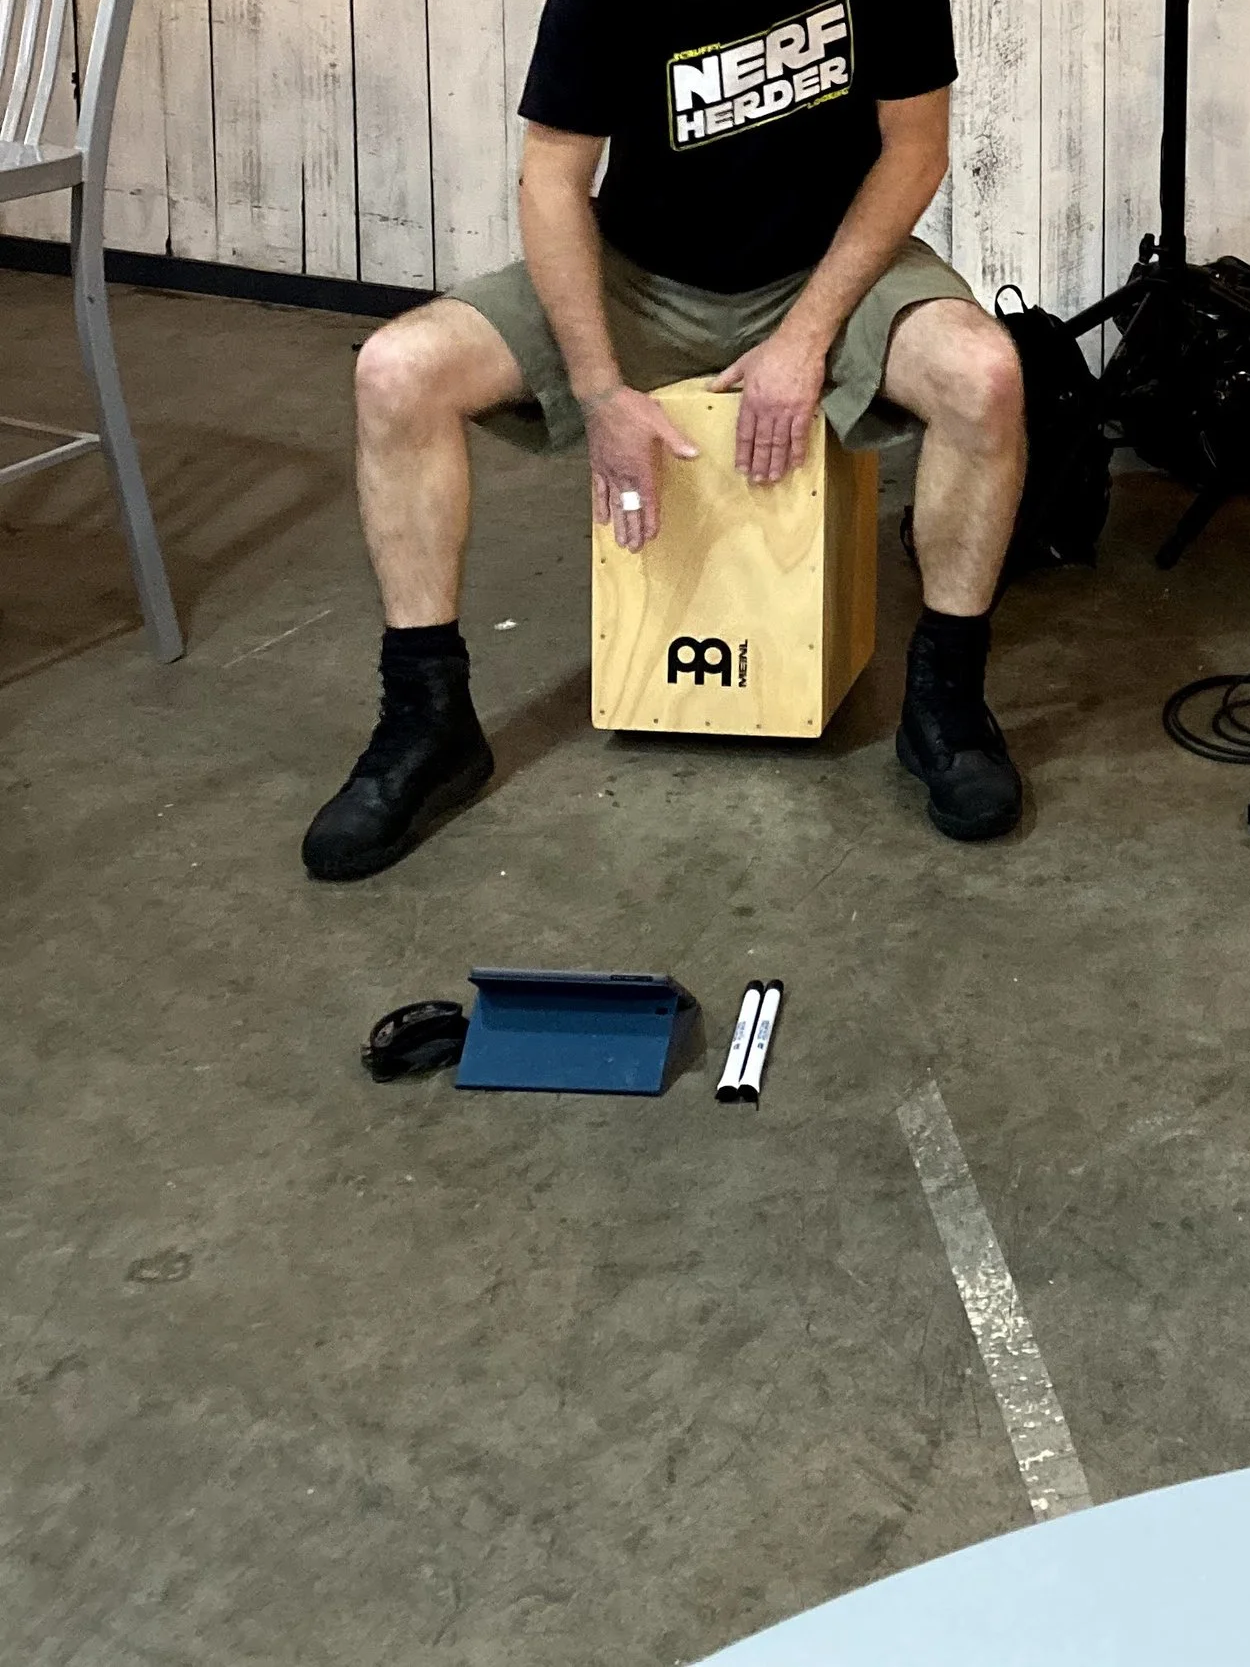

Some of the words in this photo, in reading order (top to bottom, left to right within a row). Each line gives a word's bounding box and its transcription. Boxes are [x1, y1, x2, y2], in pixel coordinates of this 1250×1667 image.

[673, 3, 848, 112] NERF
[676, 56, 849, 143] HERDER
[738, 639, 748, 688] MEINL
